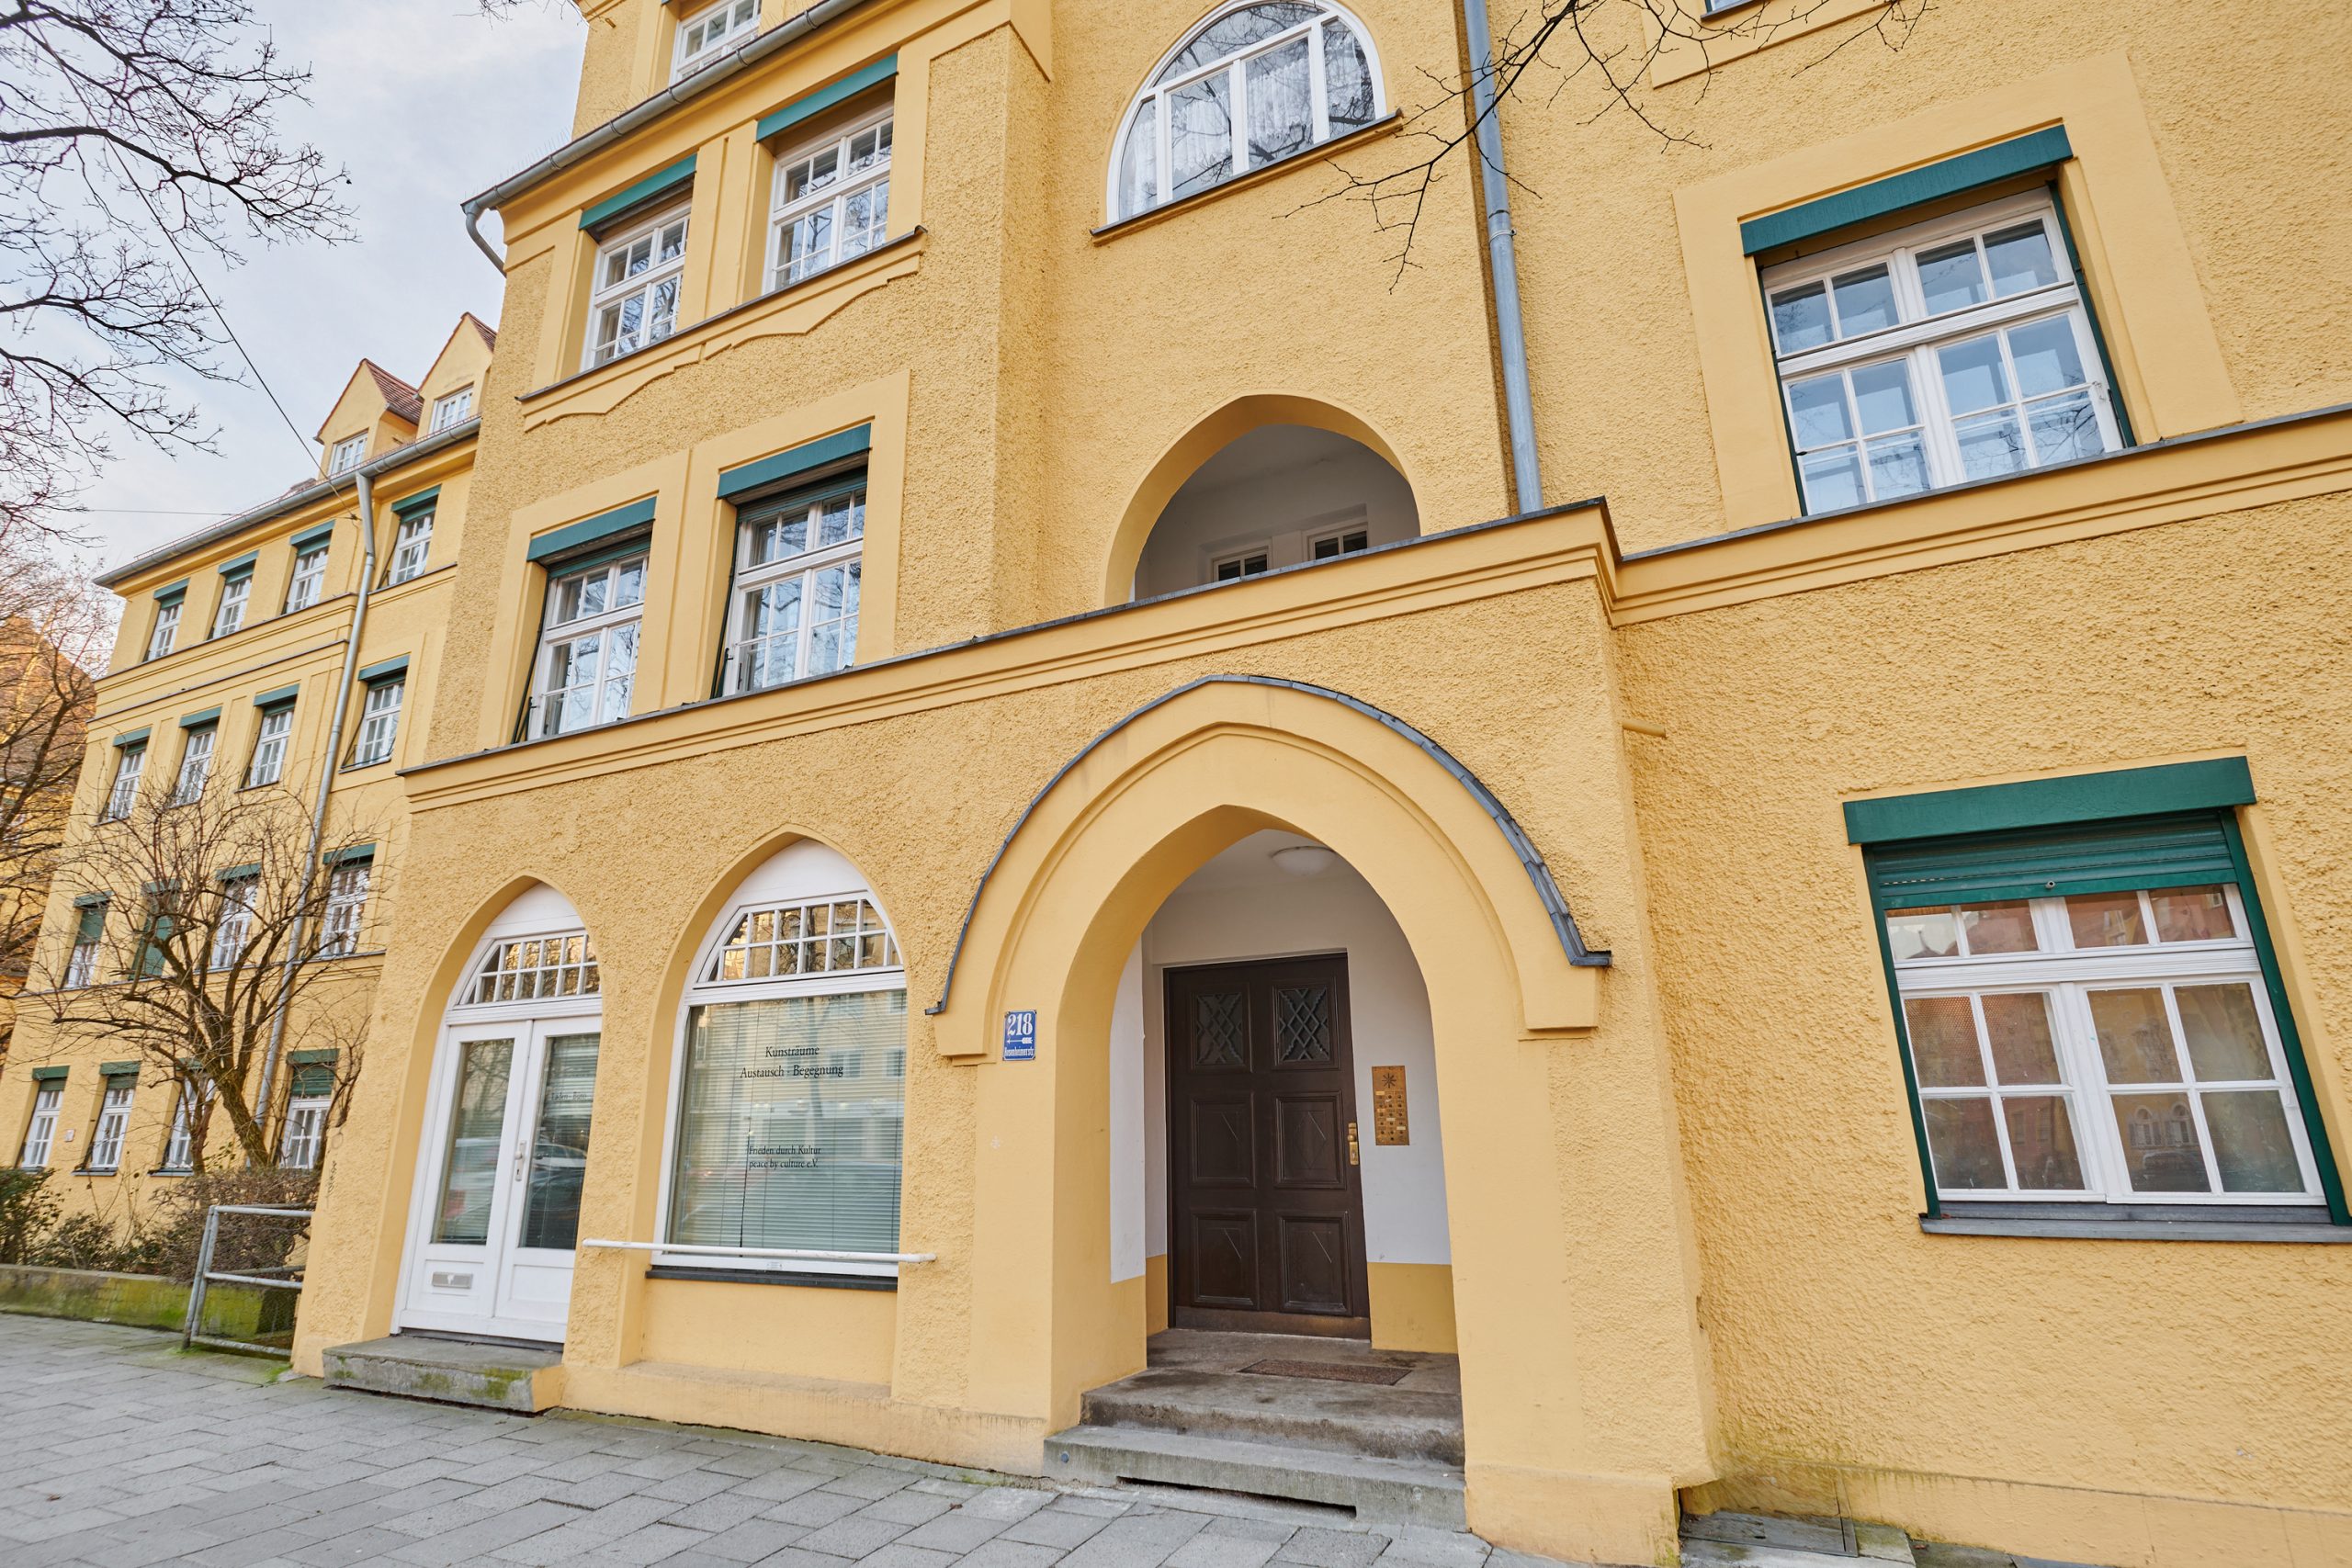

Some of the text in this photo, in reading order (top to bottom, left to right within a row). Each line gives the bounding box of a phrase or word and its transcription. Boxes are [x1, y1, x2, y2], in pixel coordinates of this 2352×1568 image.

[1007, 1013, 1034, 1036] 218
[765, 1045, 820, 1058] Kunsträume
[740, 1066, 785, 1078] Austausch
[793, 1065, 844, 1078] Begegnung
[749, 1145, 821, 1155] Frieden durch Kultur
[749, 1160, 768, 1170] peace
[769, 1157, 778, 1170] by
[780, 1157, 805, 1168] culture
